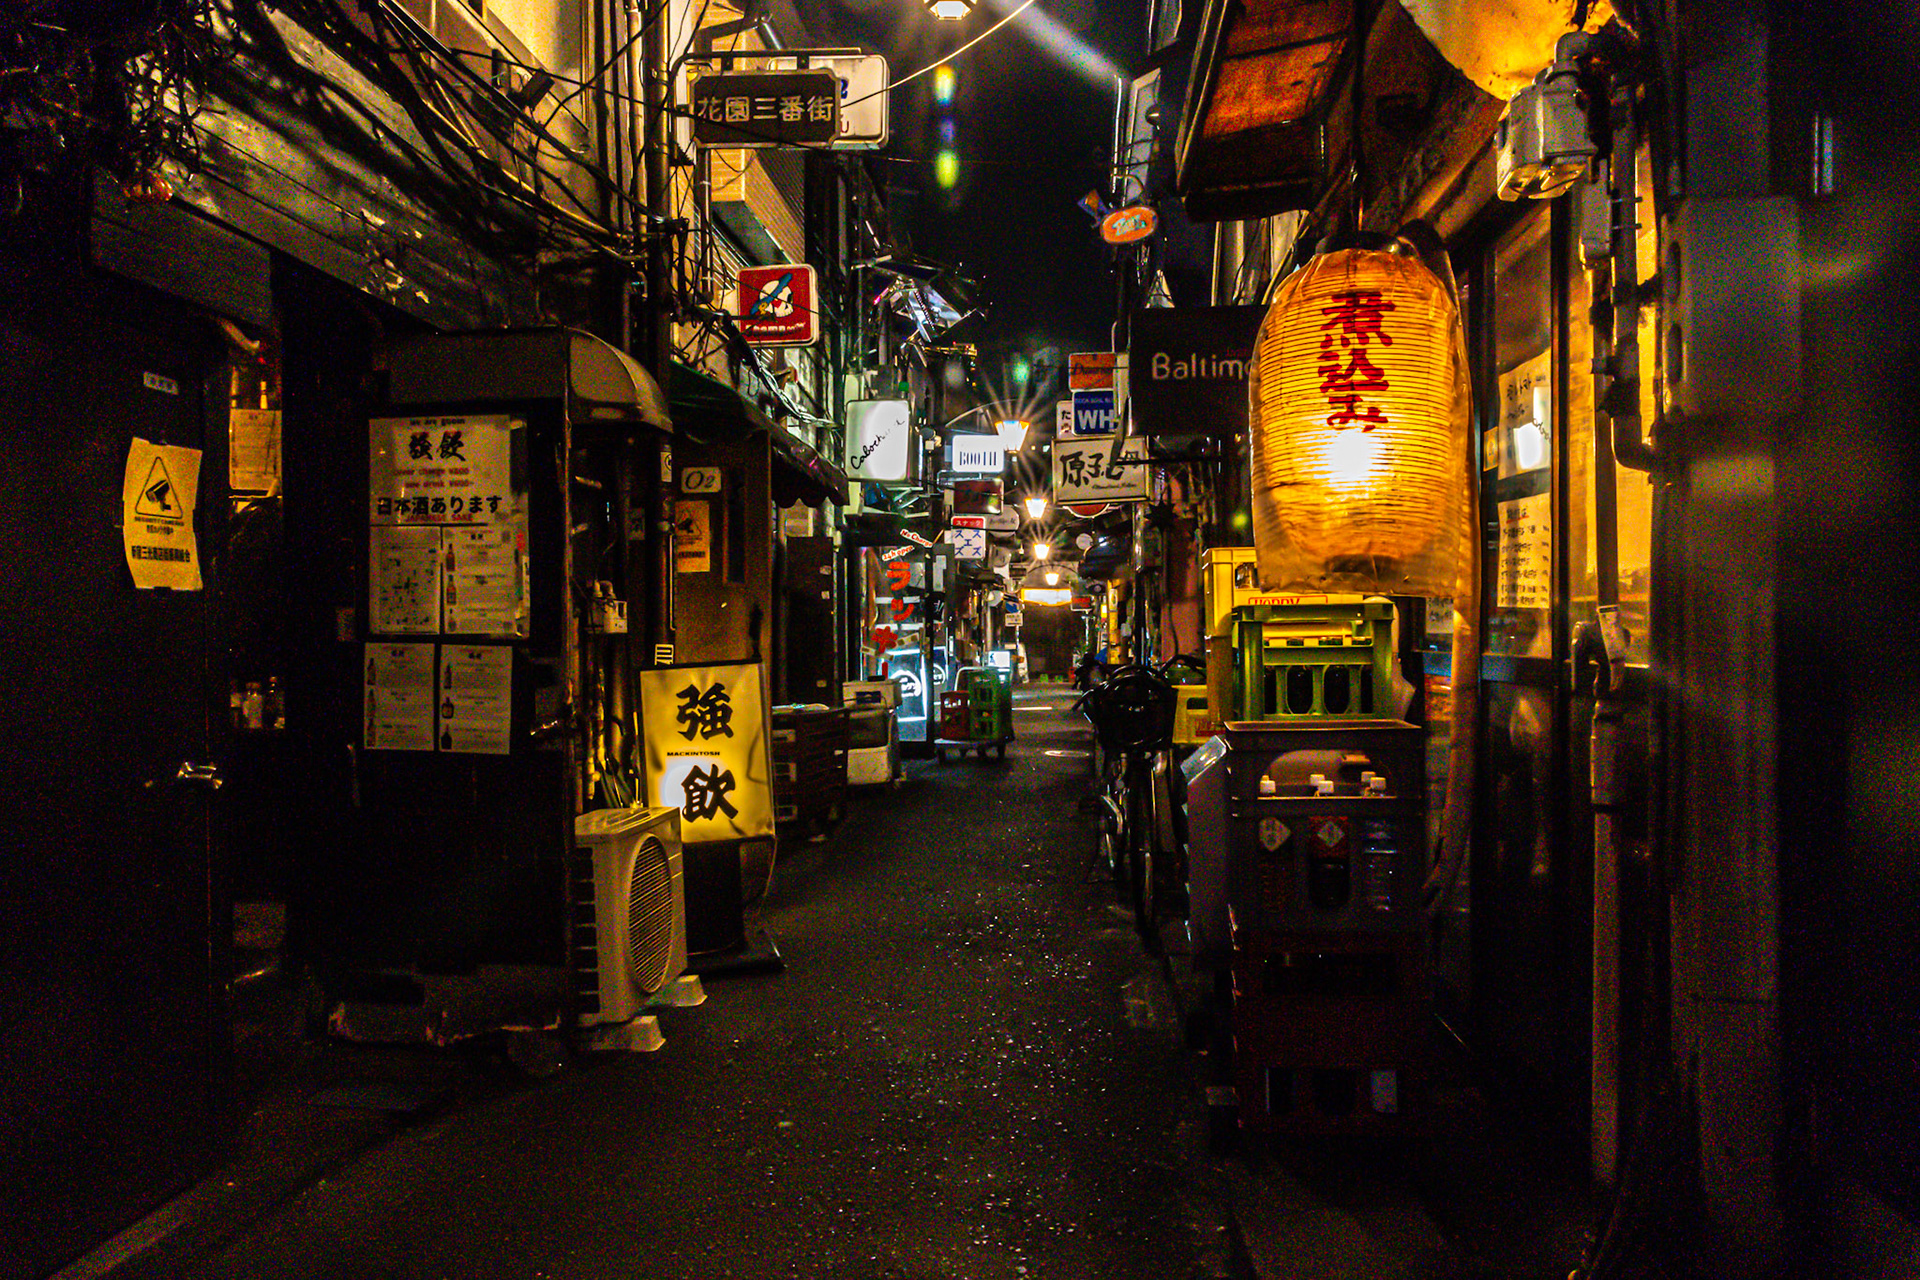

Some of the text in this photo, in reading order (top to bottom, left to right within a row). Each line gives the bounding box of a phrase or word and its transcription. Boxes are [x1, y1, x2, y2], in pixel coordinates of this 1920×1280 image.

[697, 95, 834, 123] 花園三番街
[1317, 290, 1397, 432] 煮込み
[377, 495, 502, 515] 日本酒あります
